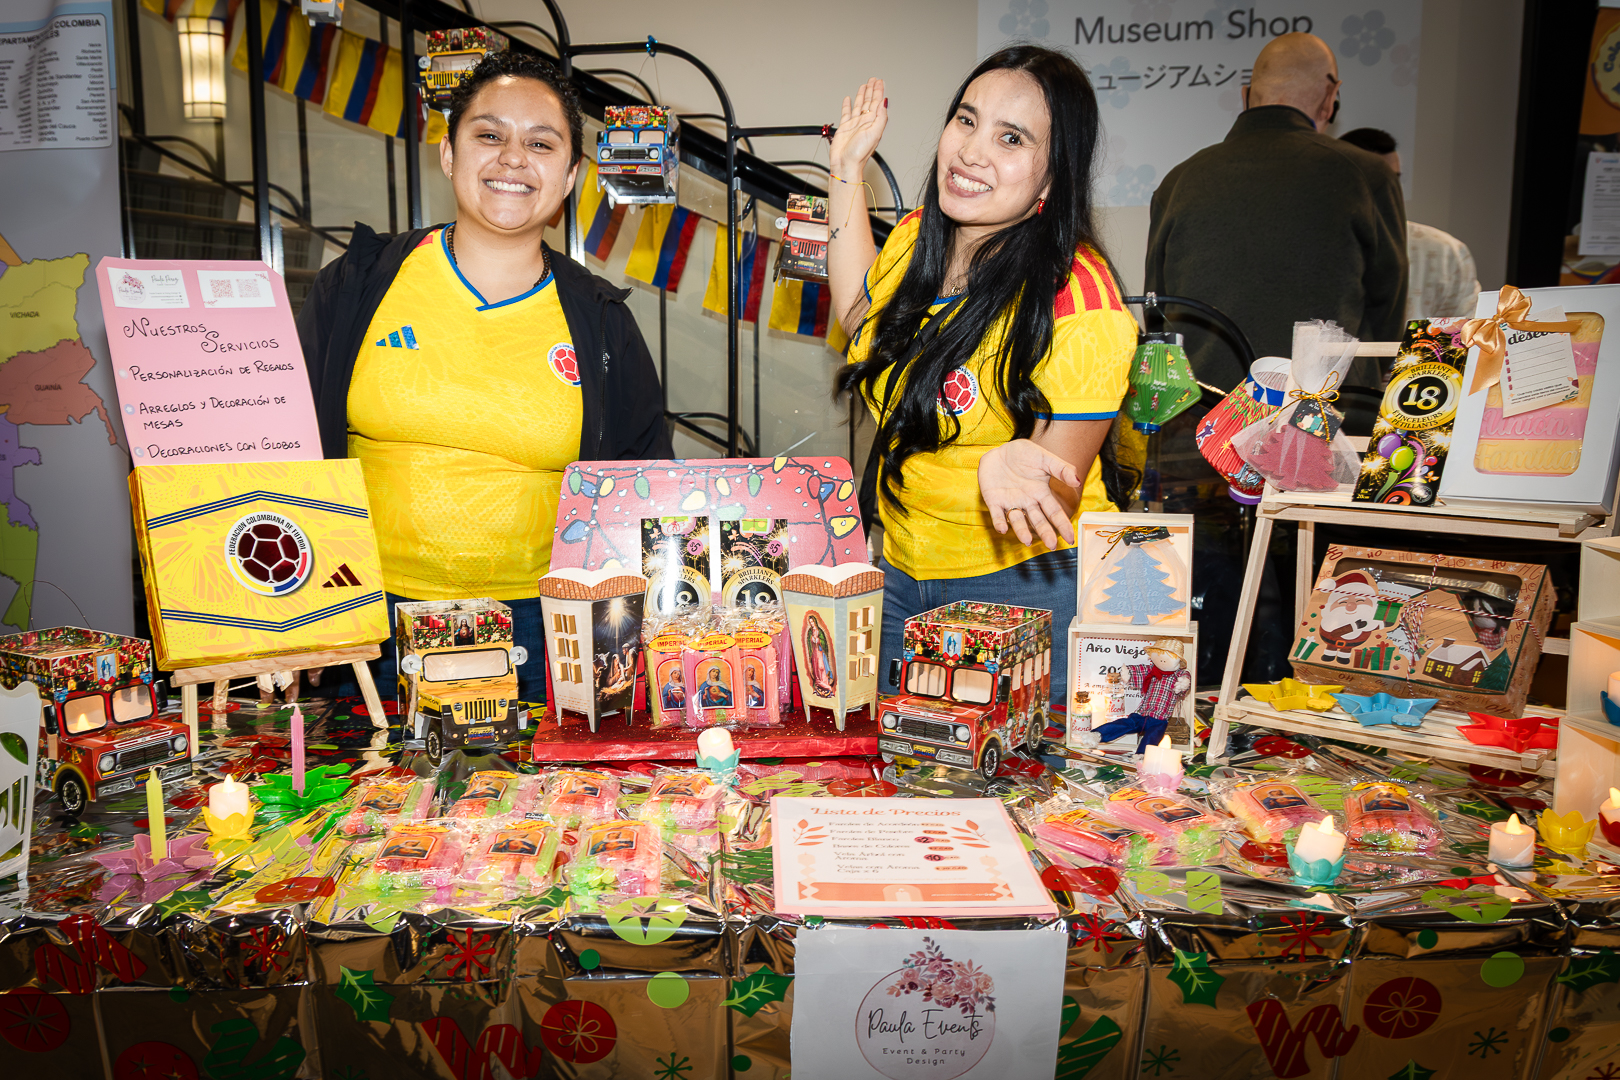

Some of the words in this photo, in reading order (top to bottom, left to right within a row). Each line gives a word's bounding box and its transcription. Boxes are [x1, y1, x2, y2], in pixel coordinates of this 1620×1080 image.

[54, 19, 101, 28] COLOMBIA
[1074, 17, 1214, 45] Museum
[1226, 8, 1313, 38] Shop
[1087, 63, 1251, 90] ュージアムショ
[200, 330, 280, 353] SERVICIOS
[129, 364, 233, 382] PERSONALIZACIÓN
[238, 366, 251, 375] DE
[1410, 364, 1452, 374] BRILLIANT
[1402, 383, 1441, 410] 18
[139, 402, 196, 415] ARREGLOS
[209, 394, 270, 409] DECORACIÓN
[274, 396, 286, 404] DE
[143, 418, 183, 430] MESAS
[147, 442, 232, 459] DECORACIONES
[236, 442, 256, 452] CON
[246, 514, 285, 525] COLOMBIANA
[690, 542, 701, 553] $5
[770, 543, 781, 554] $5
[738, 569, 774, 579] BRILLIANT
[1086, 643, 1111, 653] Año
[1115, 645, 1146, 658] Viejo
[810, 807, 859, 815] Lista
[889, 808, 960, 816] Precios
[868, 1008, 916, 1043] Paula
[921, 1008, 983, 1040] Events
[934, 1048, 966, 1057] Party
[906, 1057, 945, 1066] Design
